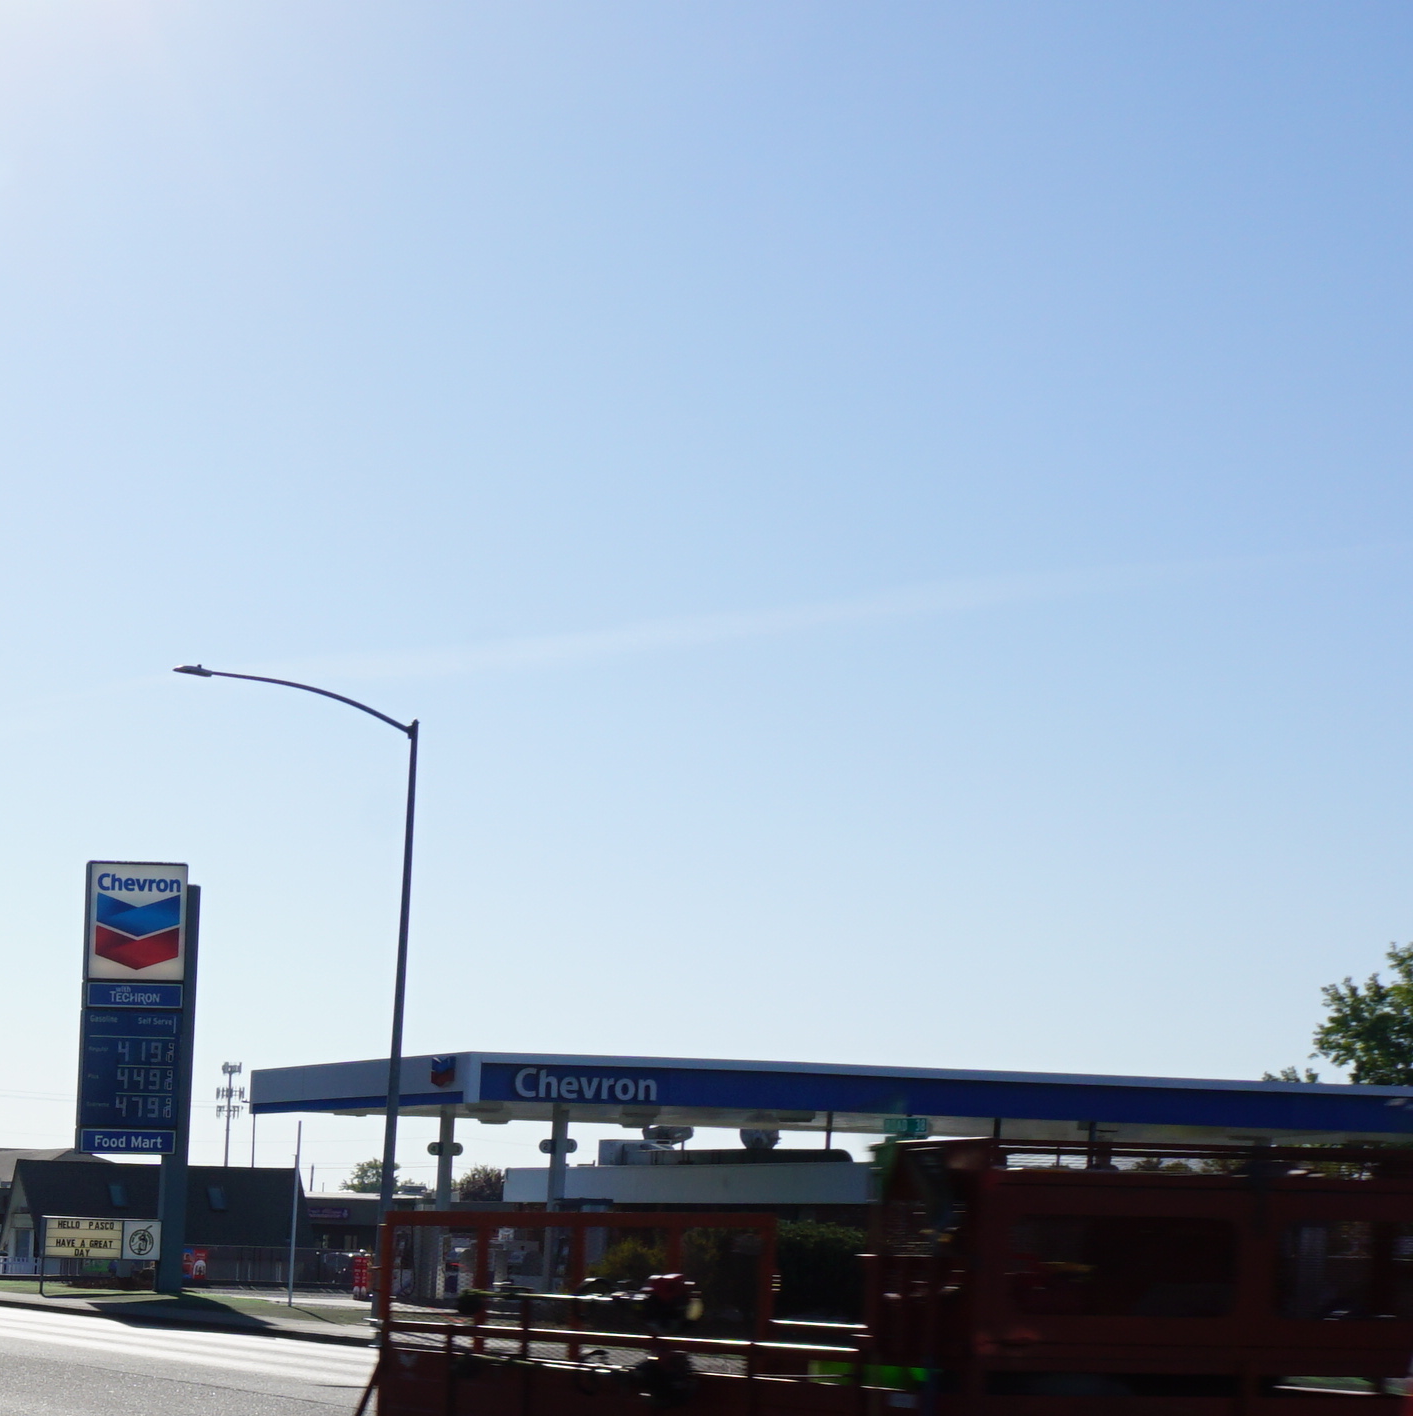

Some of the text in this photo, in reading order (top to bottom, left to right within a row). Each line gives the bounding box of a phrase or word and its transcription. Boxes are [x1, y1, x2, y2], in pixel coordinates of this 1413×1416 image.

[97, 873, 181, 893] Chevron
[89, 1014, 118, 1023] Gasoline
[137, 1017, 172, 1026] Self Serve
[514, 1067, 658, 1101] Chevron
[94, 1135, 163, 1148] Food Mart
[57, 1220, 115, 1230] HELLO PASCO
[55, 1239, 113, 1249] HAVE A GREAT
[74, 1248, 91, 1257] DAY
